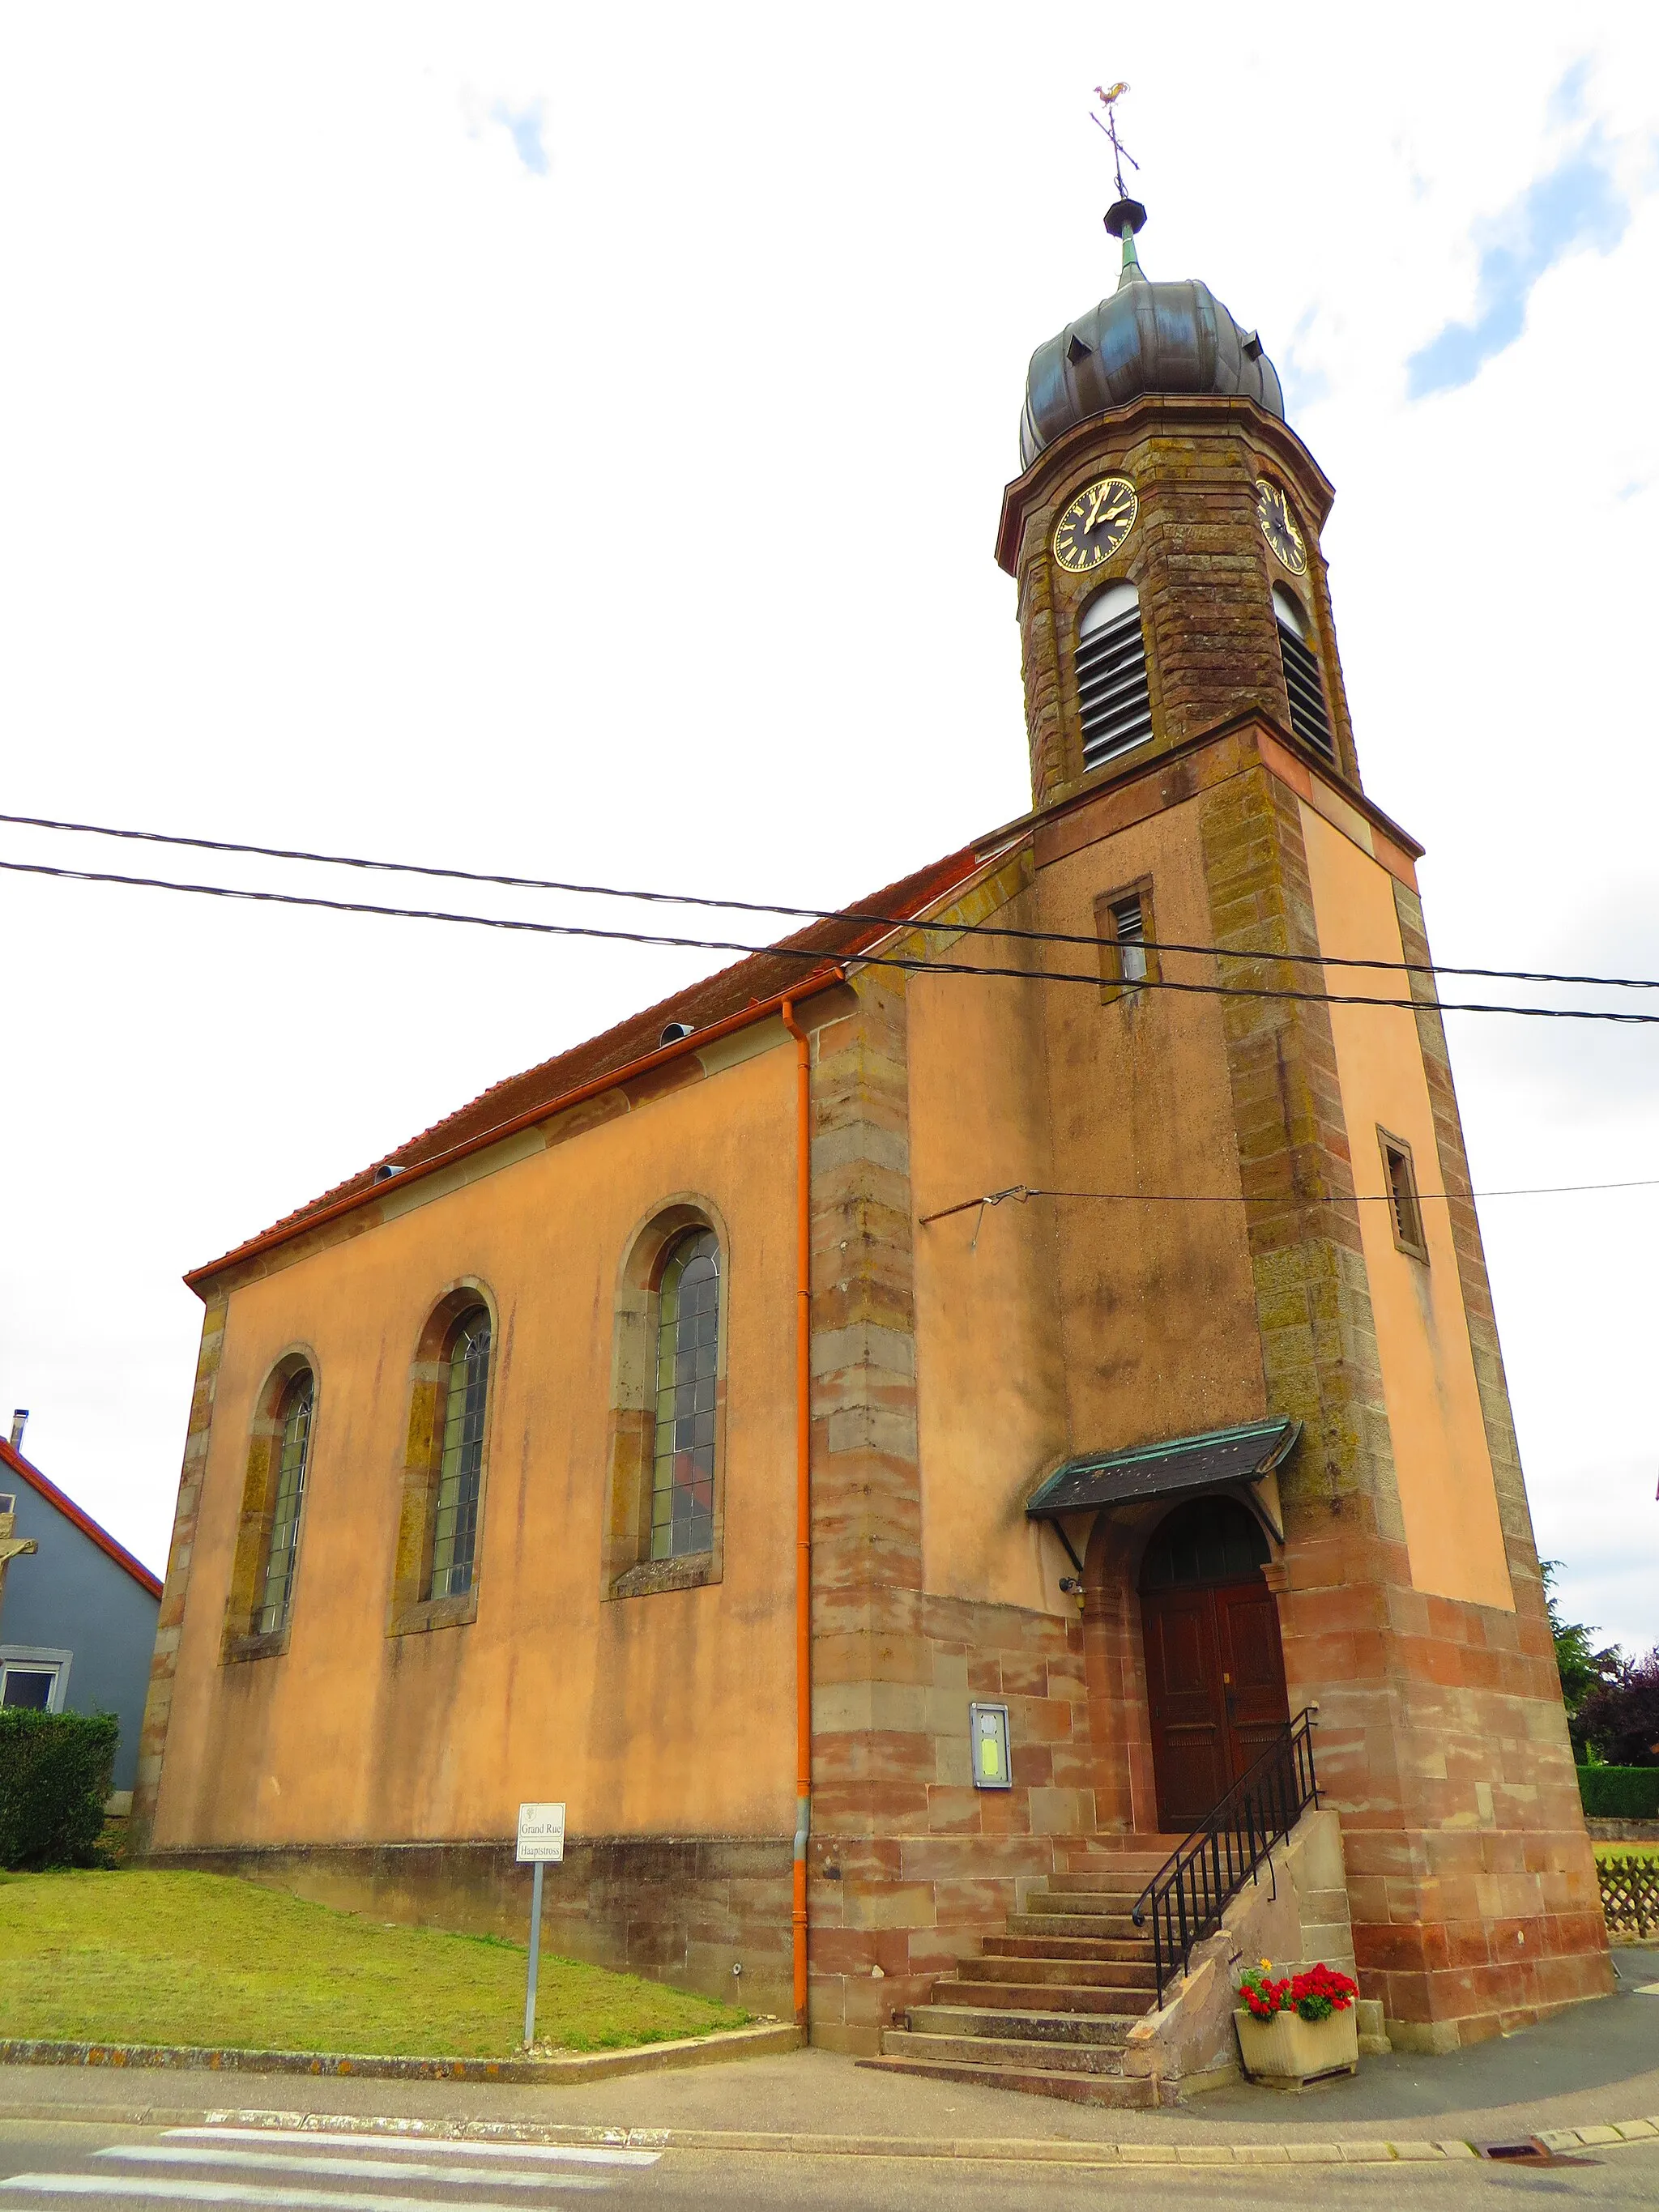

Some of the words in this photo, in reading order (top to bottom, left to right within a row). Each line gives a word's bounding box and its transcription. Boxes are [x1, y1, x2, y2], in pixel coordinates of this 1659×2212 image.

[522, 1823, 544, 1834] Grand
[546, 1823, 561, 1834] Rue
[521, 1845, 560, 1858] Haaptstross
